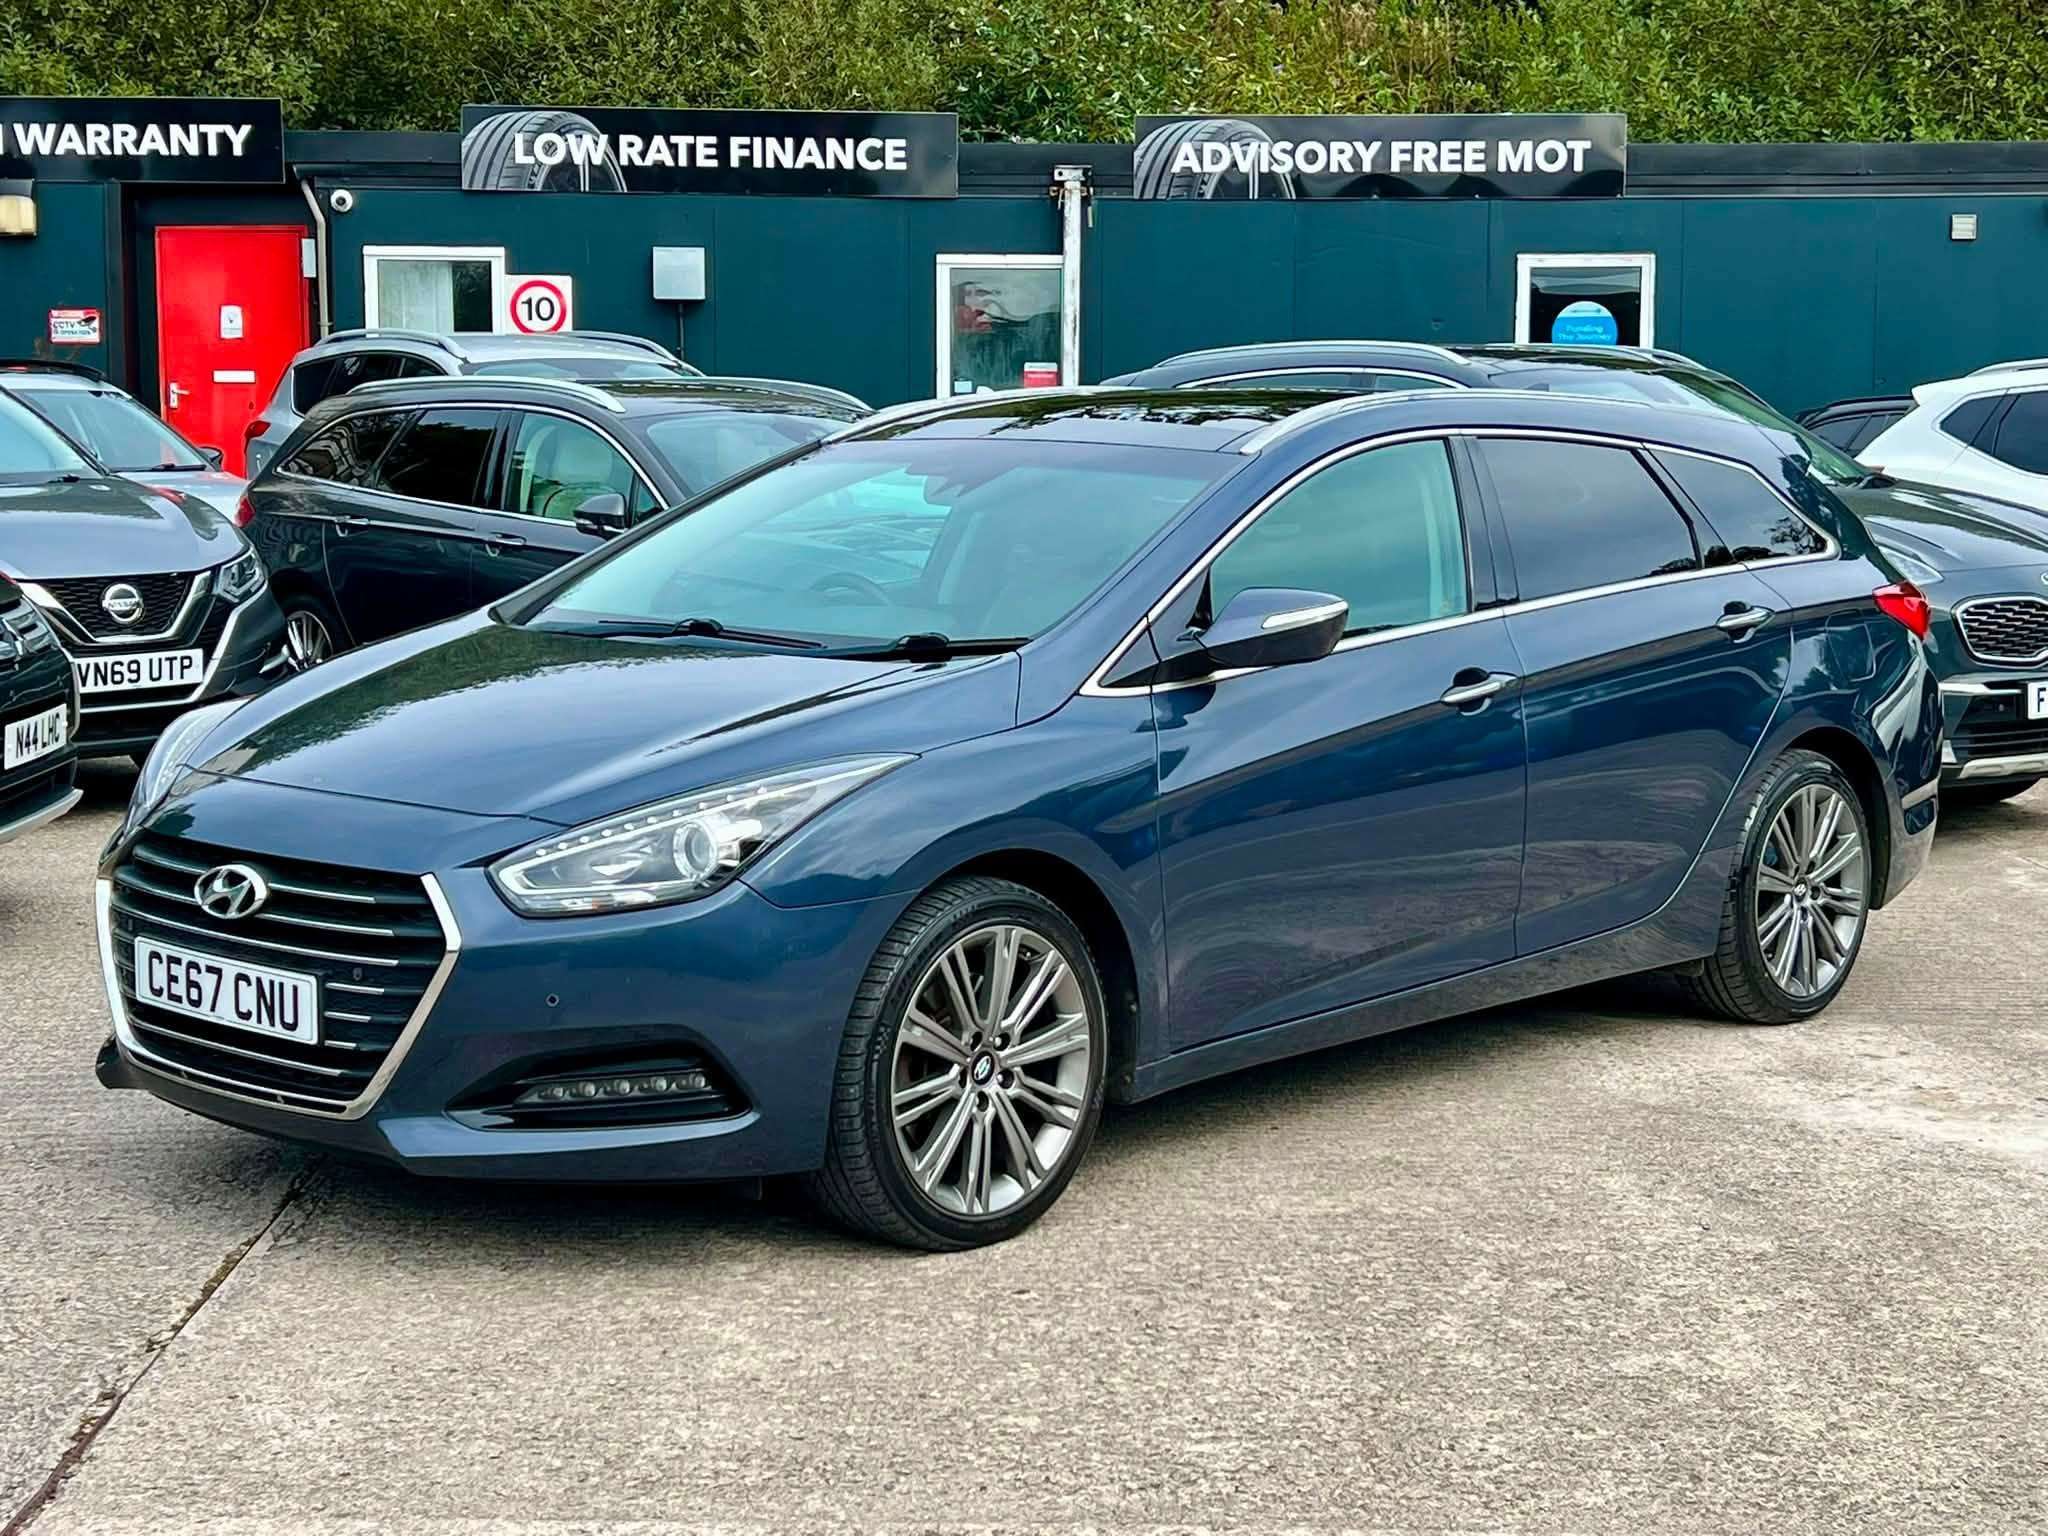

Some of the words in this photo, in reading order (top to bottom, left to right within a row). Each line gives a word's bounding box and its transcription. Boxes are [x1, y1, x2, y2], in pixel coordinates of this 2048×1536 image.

[12, 122, 252, 156] WARRANTY
[514, 132, 609, 166] LOW
[619, 134, 719, 168] RATE
[729, 136, 908, 171] FINANCE
[1170, 140, 1383, 174] ADVISORY
[1390, 140, 1487, 173] FREE
[1496, 139, 1593, 173] MOT
[53, 320, 76, 329] CCTV
[521, 296, 555, 321] 10
[77, 659, 141, 688] VN69
[149, 655, 193, 682] UTP
[148, 950, 223, 1013] CE67
[234, 972, 299, 1032] CNU
